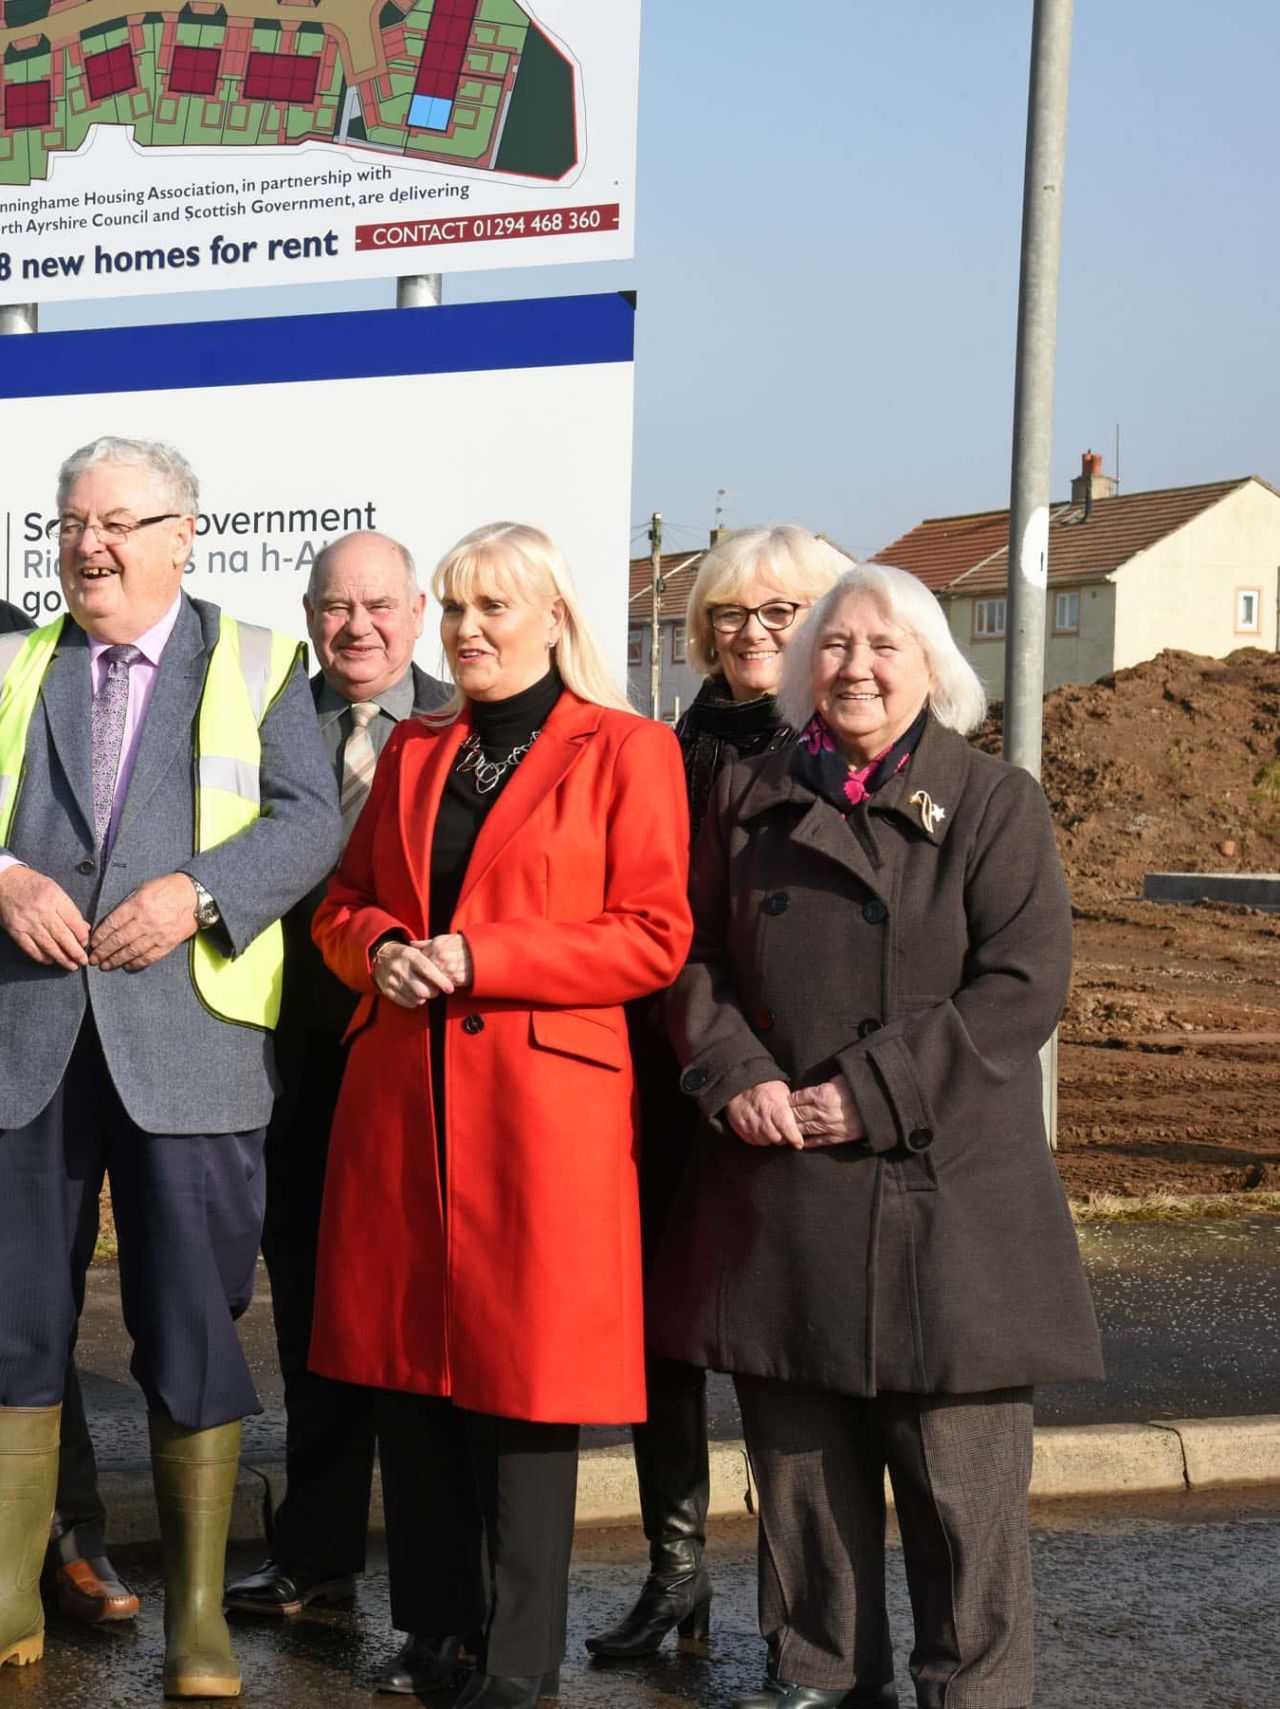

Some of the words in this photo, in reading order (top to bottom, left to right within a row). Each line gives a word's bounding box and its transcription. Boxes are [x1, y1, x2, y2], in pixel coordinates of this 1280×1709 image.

[84, 188, 145, 206] Housing
[147, 181, 239, 200] Association,
[242, 178, 256, 192] in
[261, 169, 352, 195] partnership
[357, 165, 392, 181] with
[26, 216, 88, 236] Ayrshire
[91, 209, 148, 227] Council
[152, 207, 180, 222] and
[184, 201, 246, 220] Scottish
[251, 193, 355, 214] Government,
[358, 193, 384, 204] are
[389, 183, 470, 202] delivering
[372, 221, 468, 245] CONTACT
[473, 216, 525, 237] 01294
[530, 213, 563, 232] 468
[569, 210, 601, 229] 360
[22, 255, 85, 279] new
[95, 245, 200, 274] homes
[210, 235, 258, 265] for
[268, 229, 339, 260] rent
[195, 501, 376, 536] overnment
[208, 549, 248, 573] na
